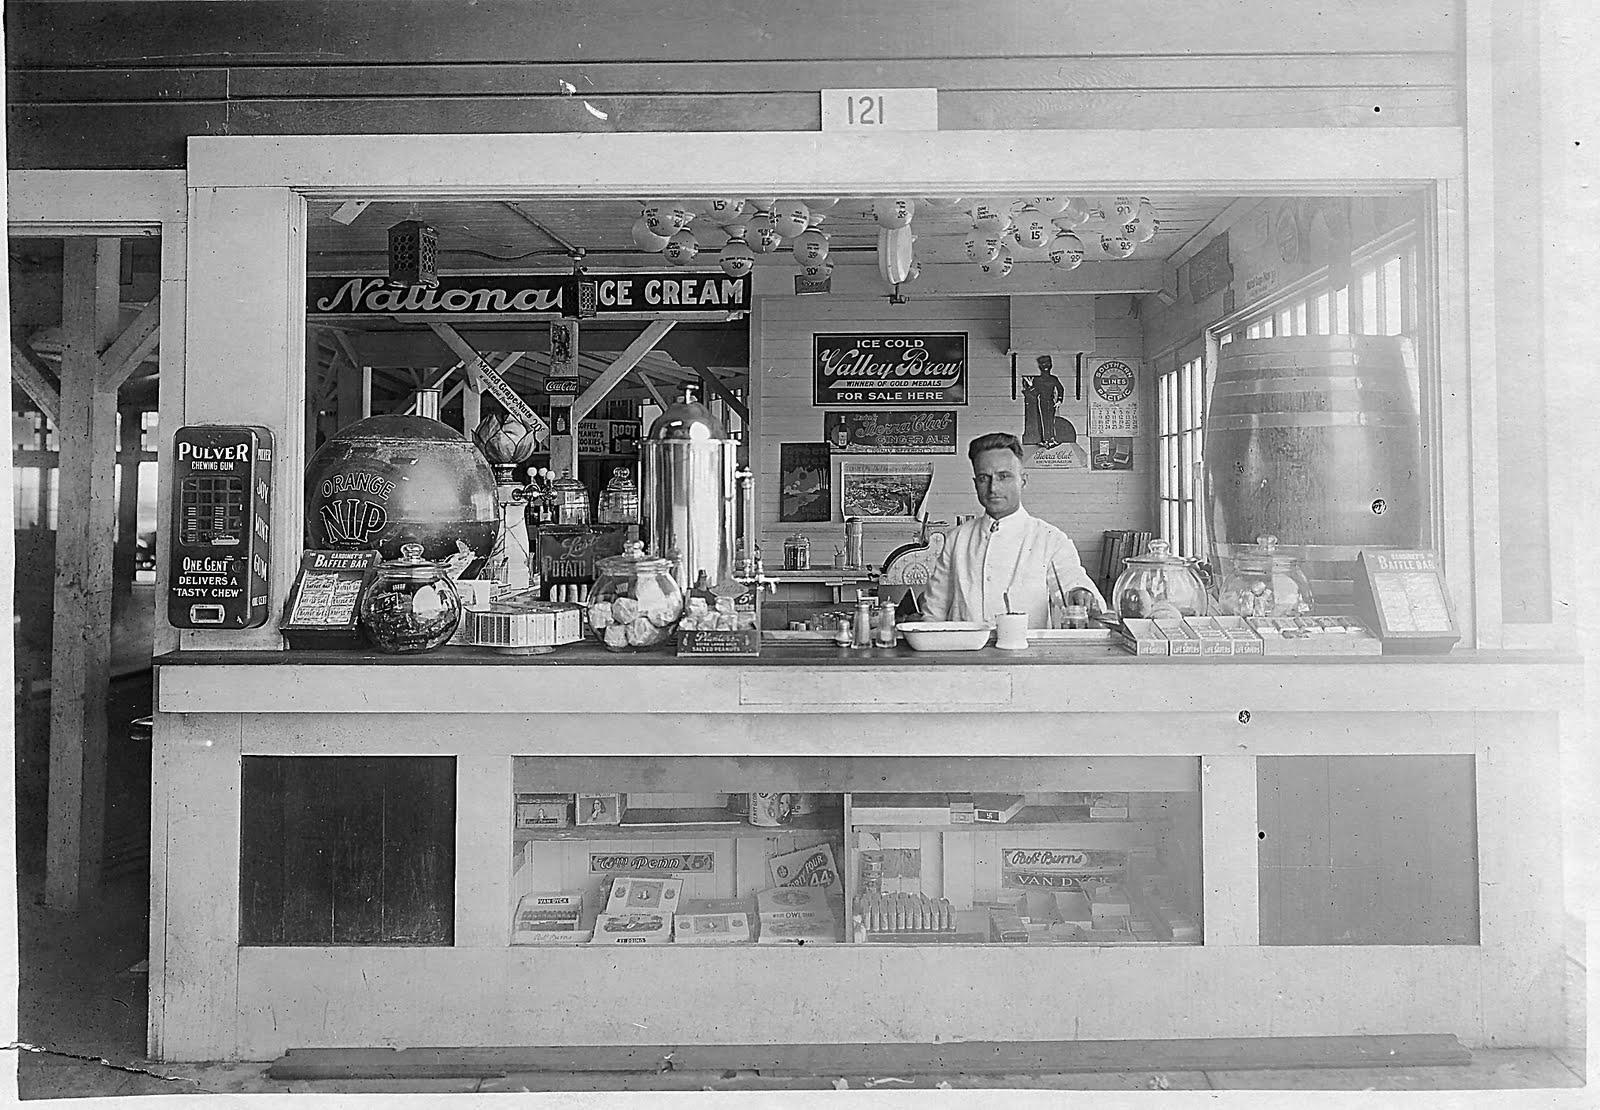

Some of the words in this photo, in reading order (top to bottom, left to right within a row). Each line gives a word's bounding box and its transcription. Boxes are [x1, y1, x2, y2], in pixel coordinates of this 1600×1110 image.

[847, 96, 884, 125] 121
[317, 278, 562, 311] Nationa
[594, 280, 633, 306] CE
[644, 279, 744, 305] CREAM
[856, 339, 881, 348] ICE
[884, 339, 925, 348] COLD
[819, 348, 894, 379] Valley
[894, 347, 963, 376] Brew
[1096, 362, 1133, 378] SOUTHERN
[477, 361, 501, 384] Malted
[1101, 378, 1128, 386] LINES
[836, 392, 864, 400] FOR
[868, 392, 903, 400] SALE
[907, 392, 944, 400] HERE
[1098, 388, 1132, 401] PACIFIC
[910, 412, 953, 432] Club
[612, 424, 637, 439] ROOT
[876, 435, 924, 445] GINGER
[926, 435, 950, 444] ALE
[178, 442, 249, 462] PULVER
[191, 461, 218, 470] CHEWING
[220, 461, 234, 470] GUM
[256, 477, 269, 504] JOY
[322, 472, 397, 501] ORANGE
[319, 498, 388, 544] NIP
[182, 556, 203, 571] ONE
[204, 556, 229, 572] CENT
[314, 554, 348, 568] BAFFLE
[350, 559, 368, 568] BAR
[541, 555, 586, 582] POTATO
[1378, 555, 1415, 570] BAFFLE
[1415, 560, 1435, 570] BAR
[178, 576, 229, 585] DELIVERS
[230, 577, 238, 586] A
[739, 593, 754, 604] 5¢
[630, 856, 680, 870] Penn
[804, 855, 824, 874] FOUR
[1040, 851, 1084, 866] Burns
[1018, 875, 1053, 886] VAN
